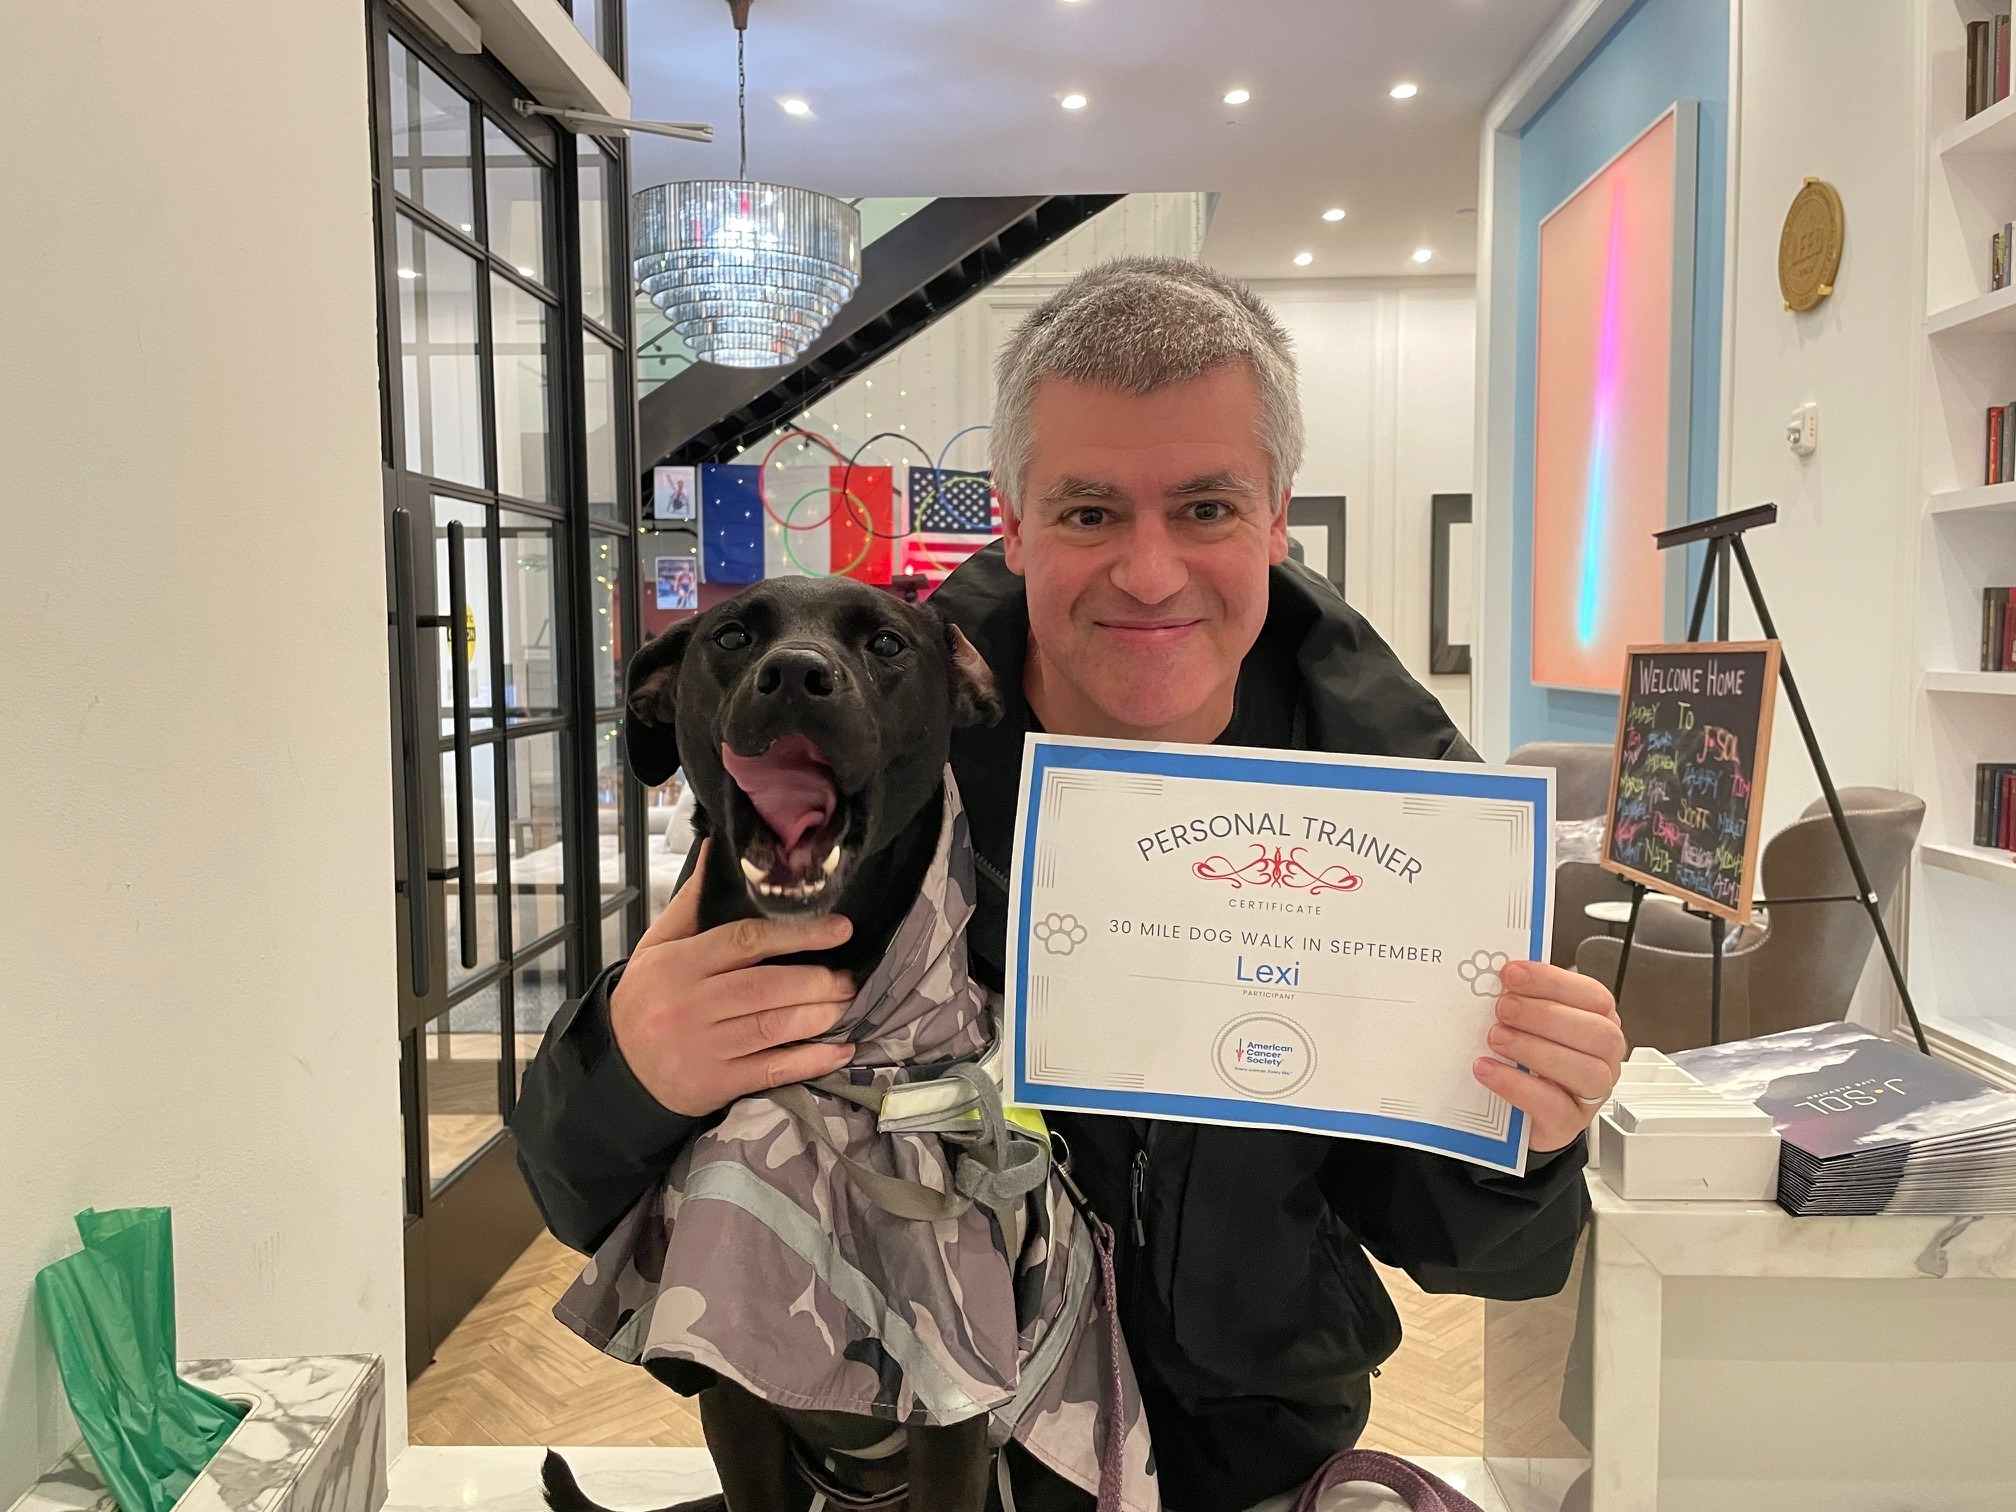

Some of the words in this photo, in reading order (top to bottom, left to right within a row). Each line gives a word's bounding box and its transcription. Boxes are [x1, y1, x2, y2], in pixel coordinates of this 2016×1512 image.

[1639, 659, 1703, 696] WELCOME
[1706, 658, 1746, 697] HOME
[1677, 798, 1710, 831] SCOTT
[1137, 812, 1291, 862] PERSONAL
[1302, 815, 1423, 884] TRAINER
[1228, 898, 1322, 915] CERTIFICATE
[1109, 919, 1131, 934] 30
[1140, 922, 1180, 939] MILE
[1189, 926, 1233, 943] DOG
[1241, 931, 1294, 949] WALK
[1303, 936, 1321, 952] IN
[1330, 940, 1443, 963] SEPTEMBER
[1236, 955, 1300, 986] Lexi
[1242, 989, 1296, 1000] PARTICIPANT
[1246, 1049, 1281, 1058] Cancer
[1247, 1041, 1293, 1053] American
[1246, 1056, 1282, 1067] Society
